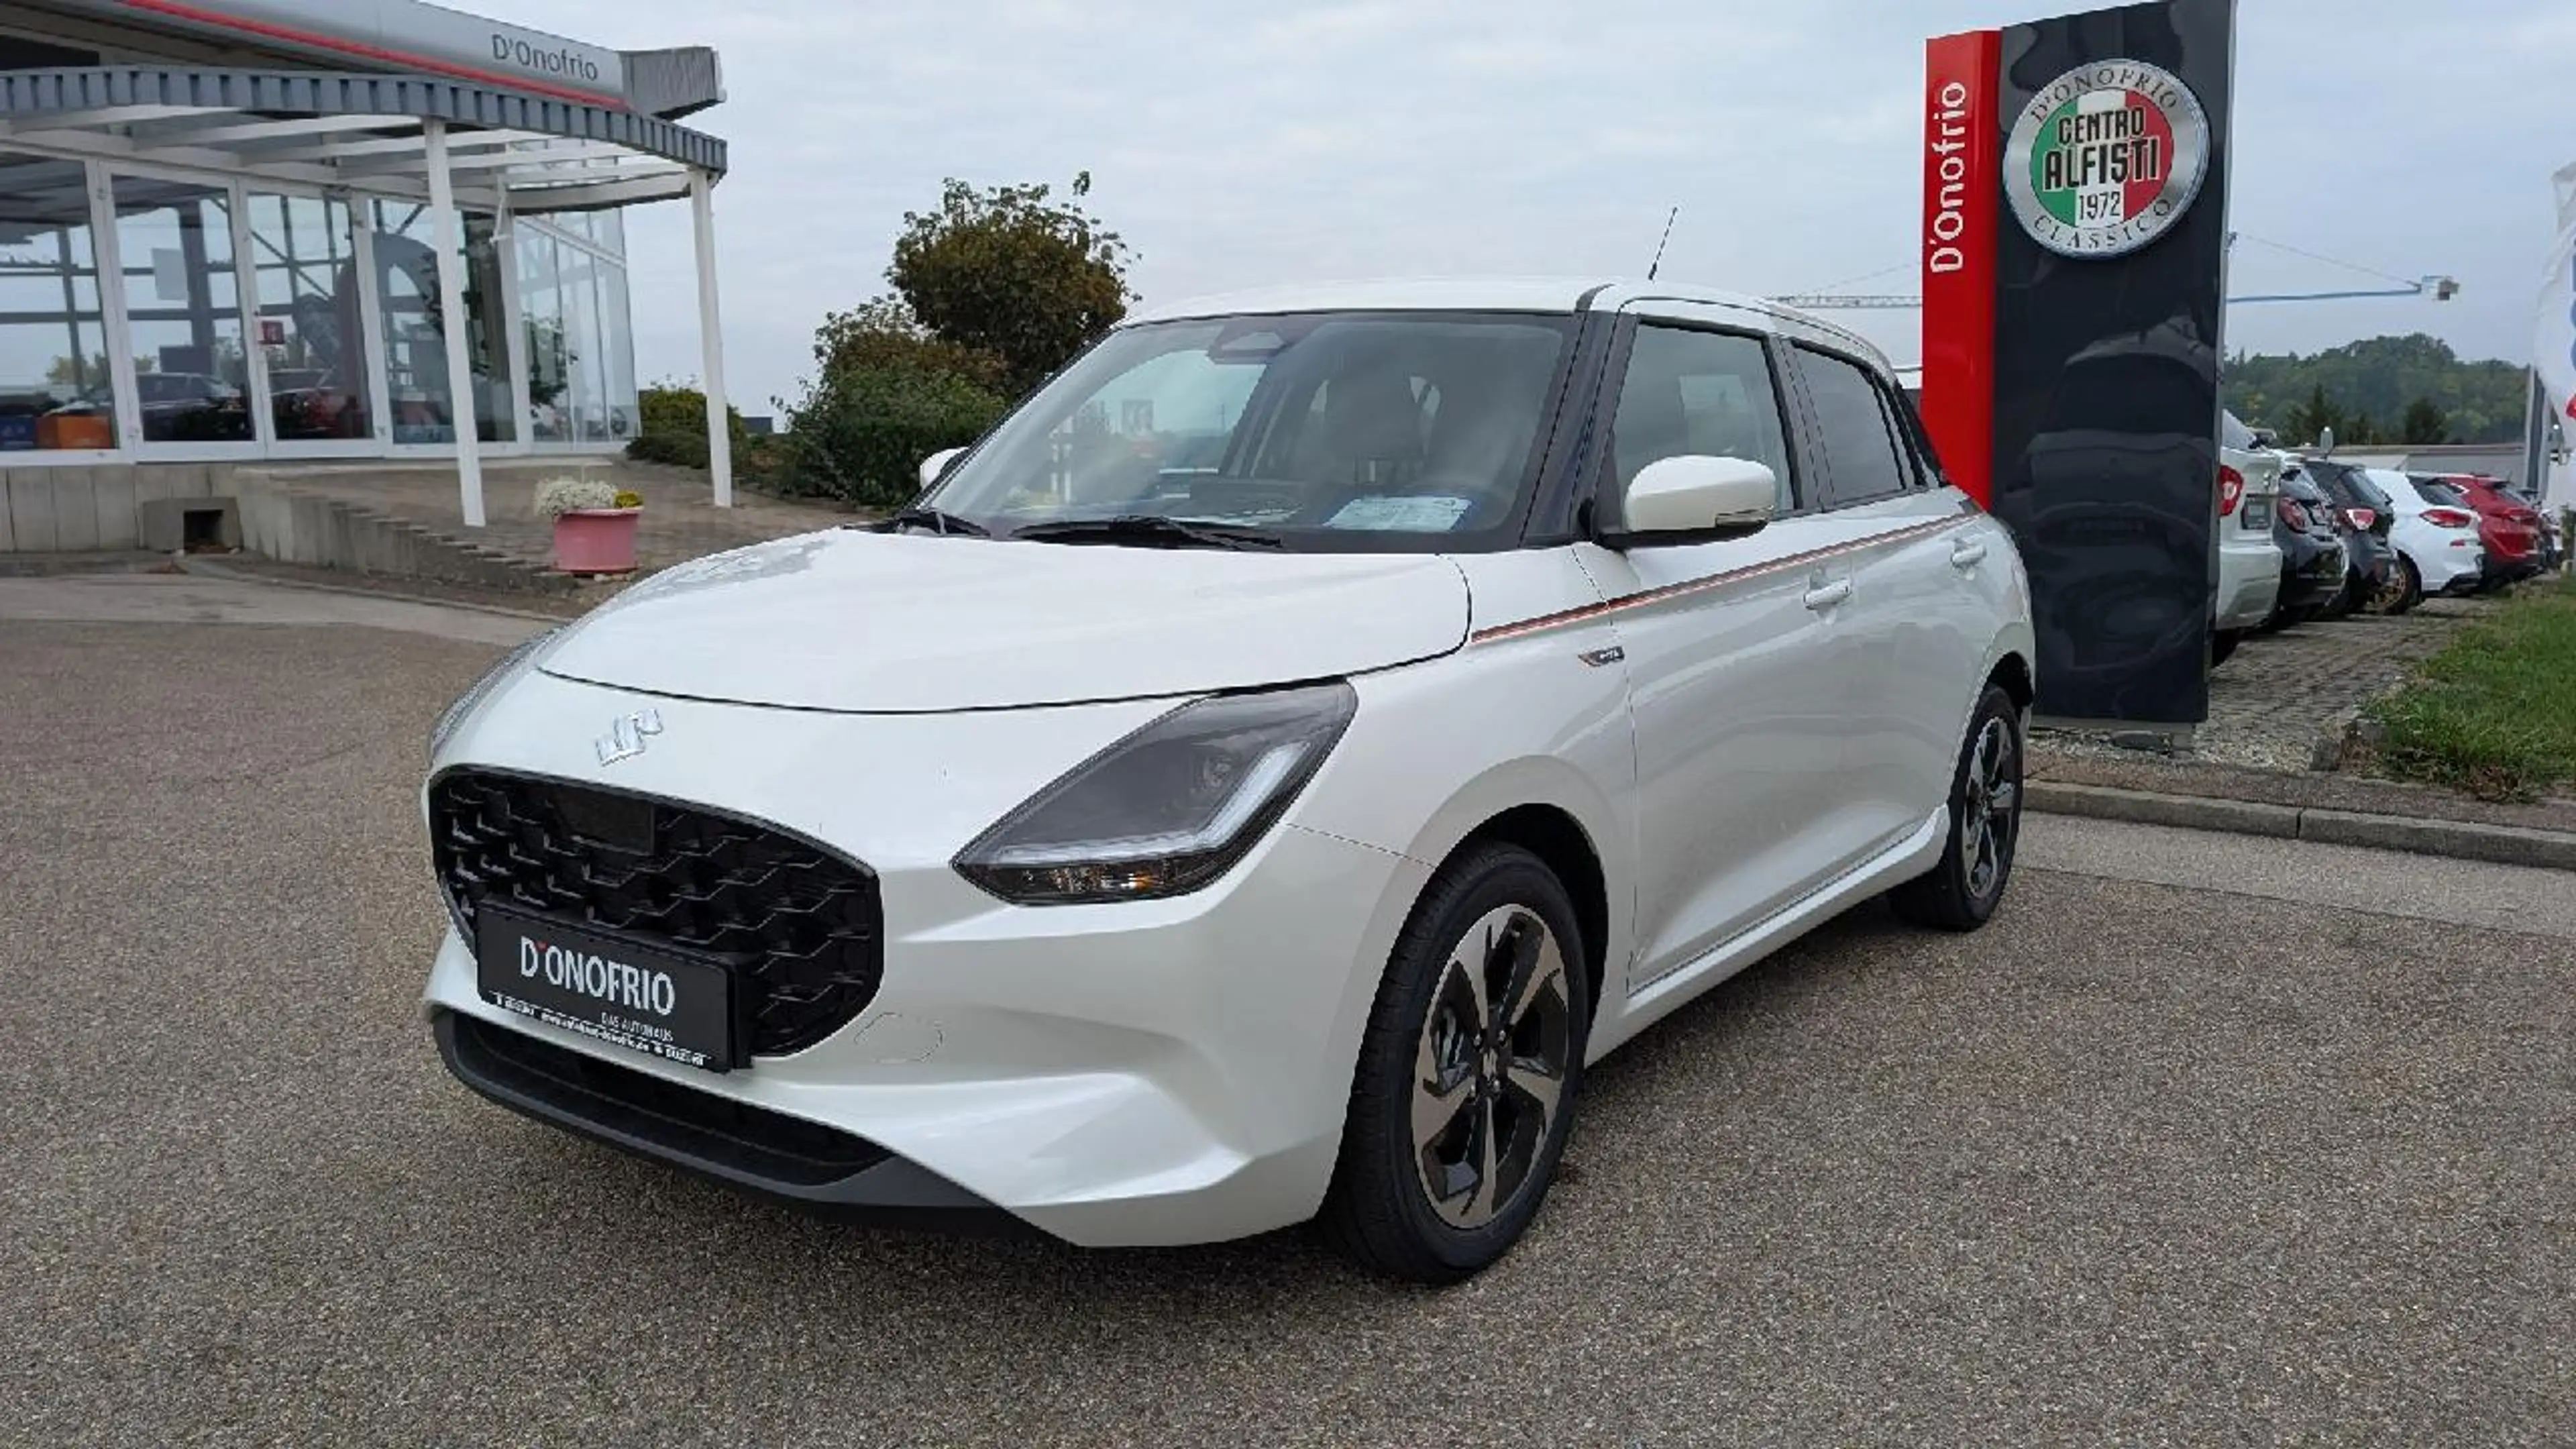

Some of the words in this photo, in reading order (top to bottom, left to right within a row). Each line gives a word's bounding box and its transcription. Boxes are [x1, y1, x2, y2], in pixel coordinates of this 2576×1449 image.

[492, 34, 598, 81] D'Onofrio
[2058, 107, 2145, 144] CENTRO
[1930, 82, 1966, 273] D'Onofrio
[2044, 136, 2159, 191] ALFISTI
[2034, 199, 2171, 249] CLASSICO
[2078, 191, 2121, 220] 1972
[521, 936, 676, 1016] D'ONOFRIO
